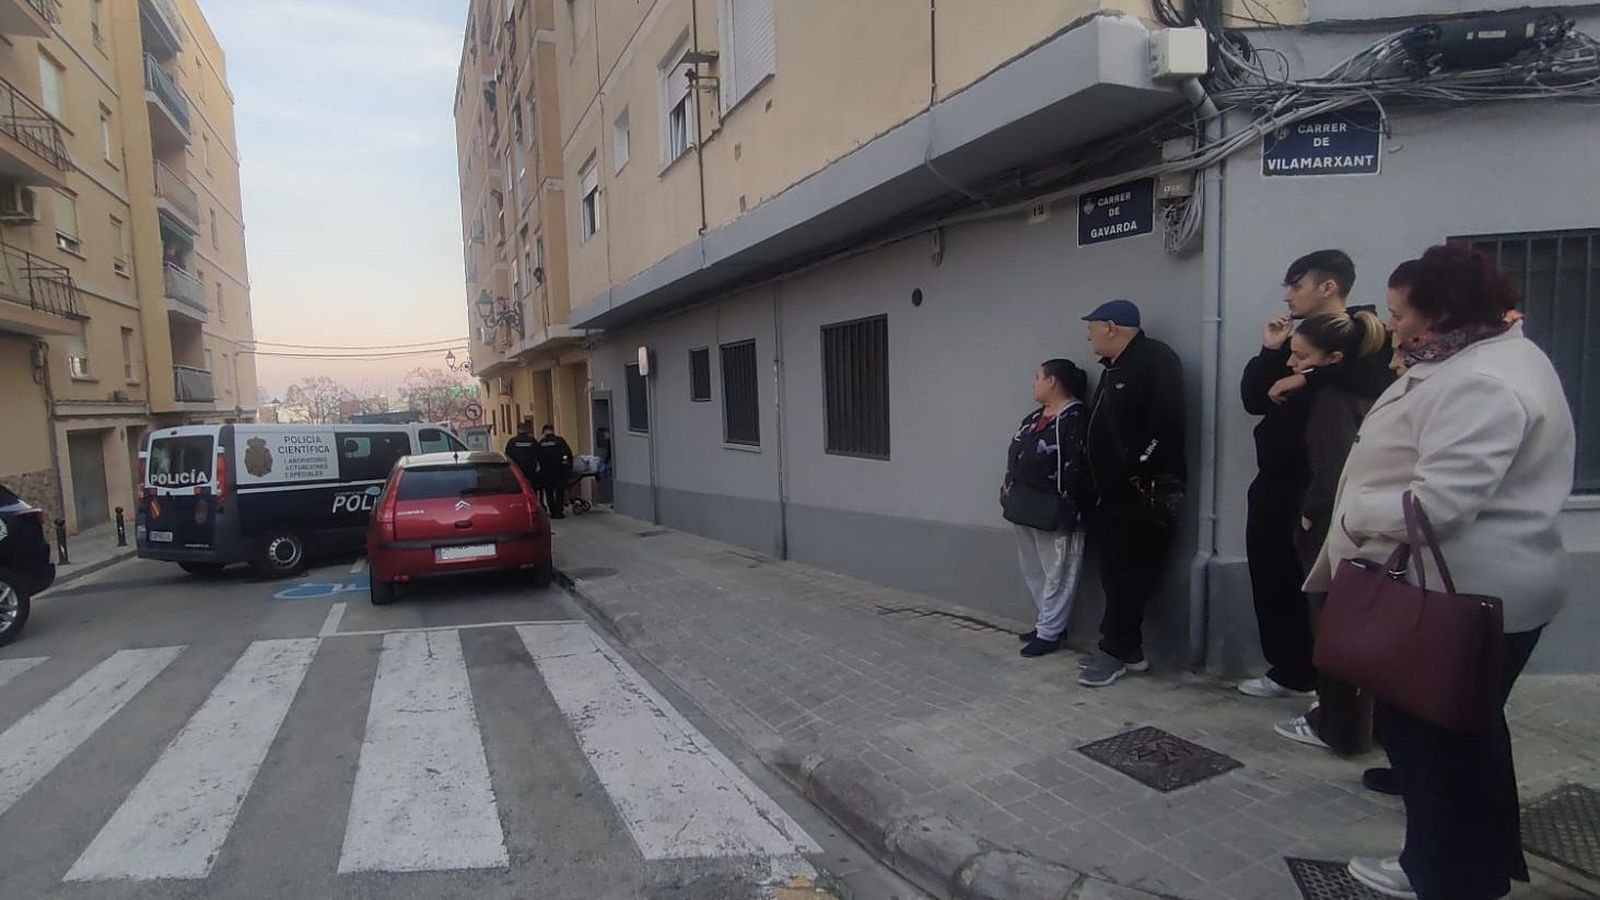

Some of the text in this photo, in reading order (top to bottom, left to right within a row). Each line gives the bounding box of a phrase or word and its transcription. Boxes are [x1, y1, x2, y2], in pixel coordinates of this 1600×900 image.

[1298, 123, 1347, 134] CARRER
[1313, 137, 1330, 147] DE
[1268, 155, 1374, 170] VILAMARXANT
[1098, 192, 1131, 206] CARRER
[1109, 206, 1120, 217] DE
[1091, 221, 1137, 238] GAVARDA
[150, 469, 208, 485] POLICÍA
